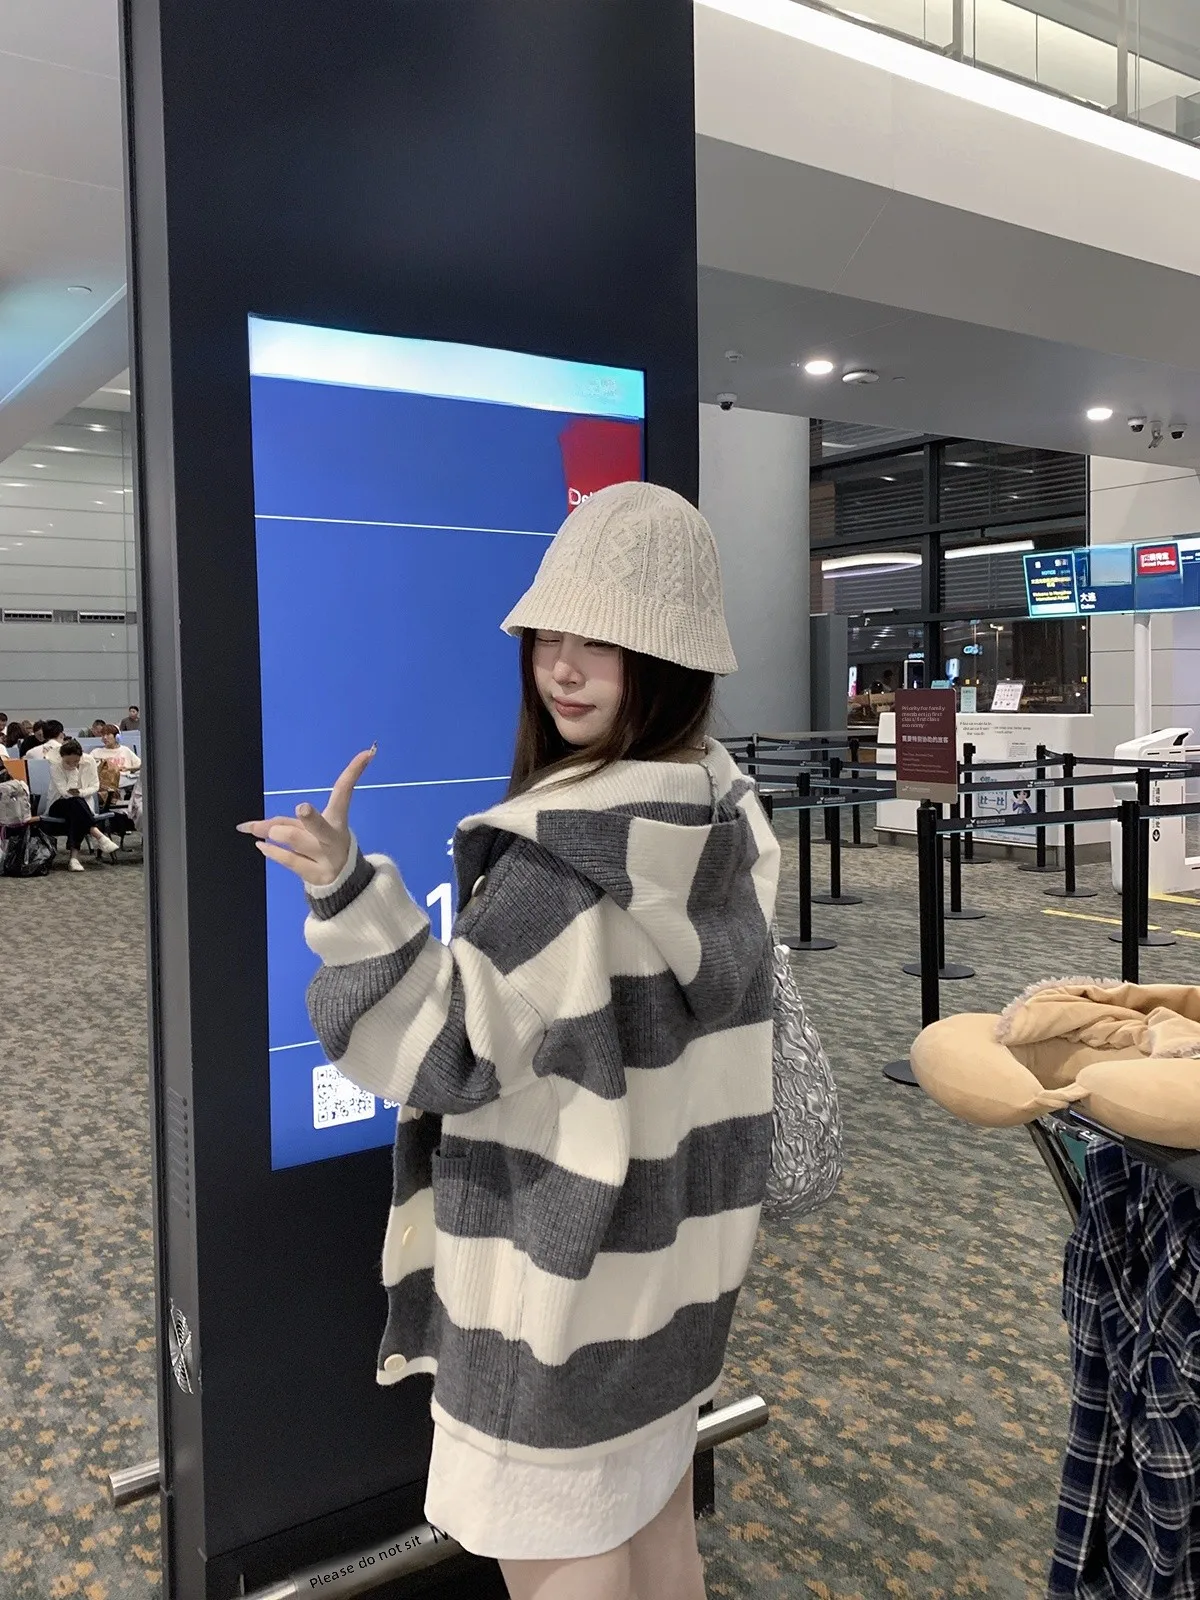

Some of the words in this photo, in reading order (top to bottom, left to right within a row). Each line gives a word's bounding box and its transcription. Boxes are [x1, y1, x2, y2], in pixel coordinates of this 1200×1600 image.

[568, 487, 593, 506] De
[981, 796, 1004, 805] 比一比
[309, 1564, 355, 1589] Please
[358, 1556, 376, 1569] do
[378, 1543, 402, 1561] not
[404, 1535, 422, 1550] sit
